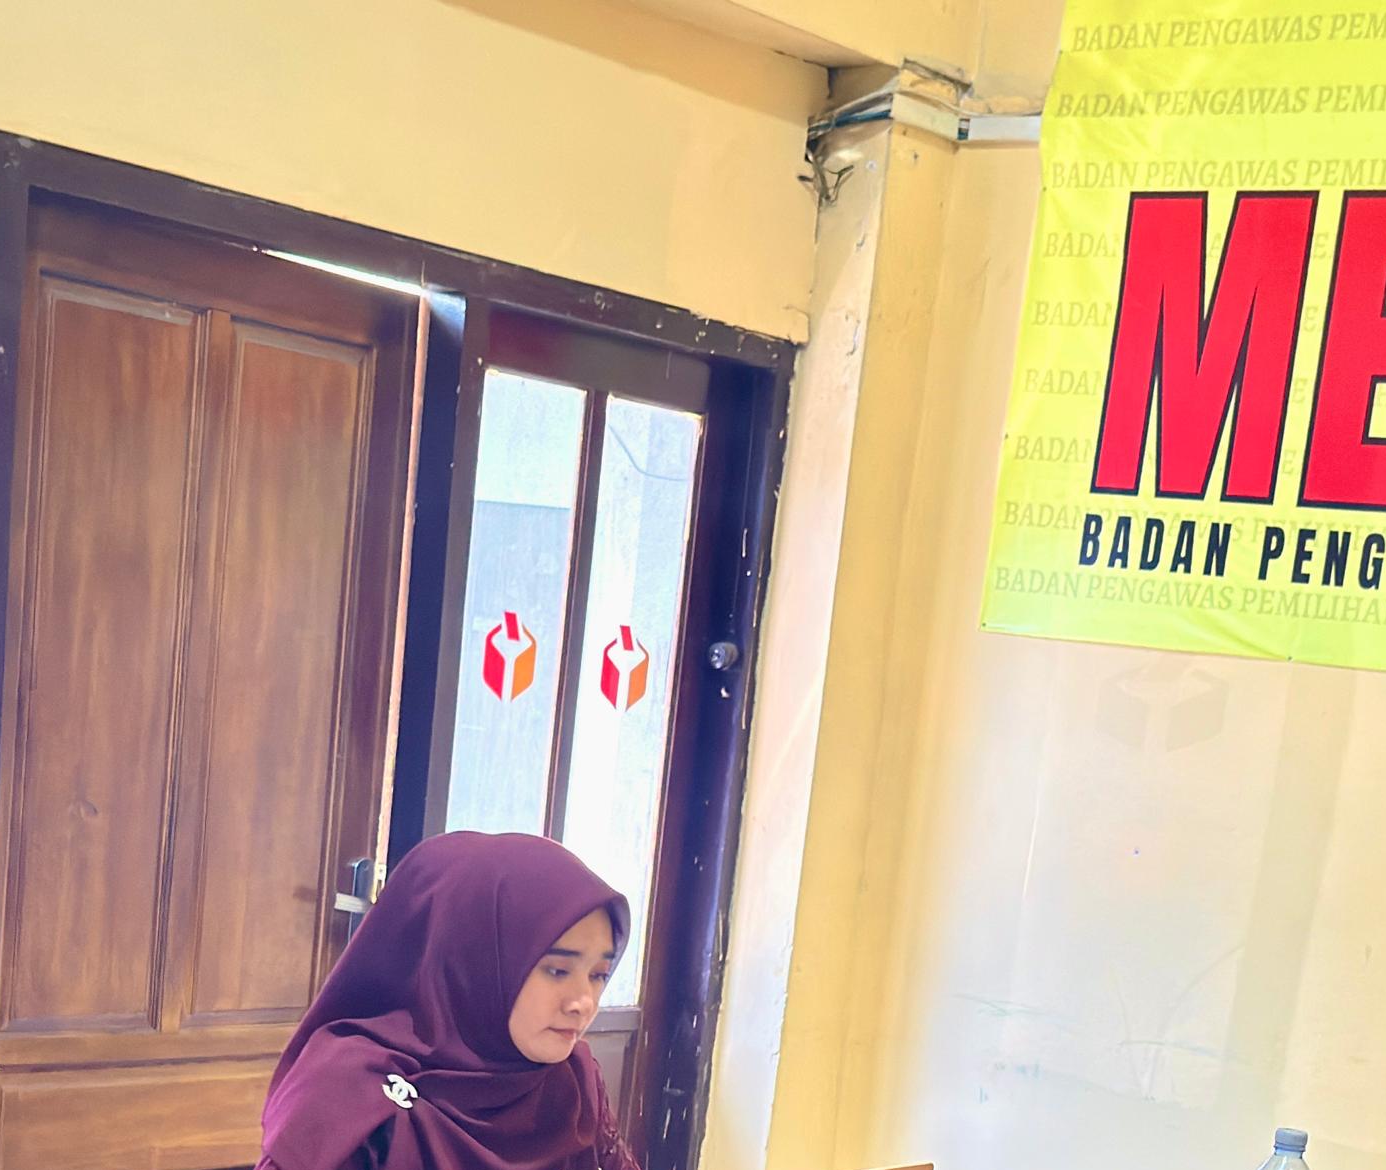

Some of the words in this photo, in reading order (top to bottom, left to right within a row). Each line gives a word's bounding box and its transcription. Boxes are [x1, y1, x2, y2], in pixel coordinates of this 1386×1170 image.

[1072, 21, 1161, 53] BADAN
[1166, 15, 1322, 48] PENGAWAS
[1056, 90, 1149, 119] BADAN
[1156, 85, 1309, 117] PENGAWAS
[1051, 161, 1137, 190] BADAN
[1144, 158, 1298, 189] PENGAWAS
[1079, 513, 1233, 578] BADAN
[994, 566, 1081, 600] BADAN
[1087, 575, 1235, 611] PENGAWAS
